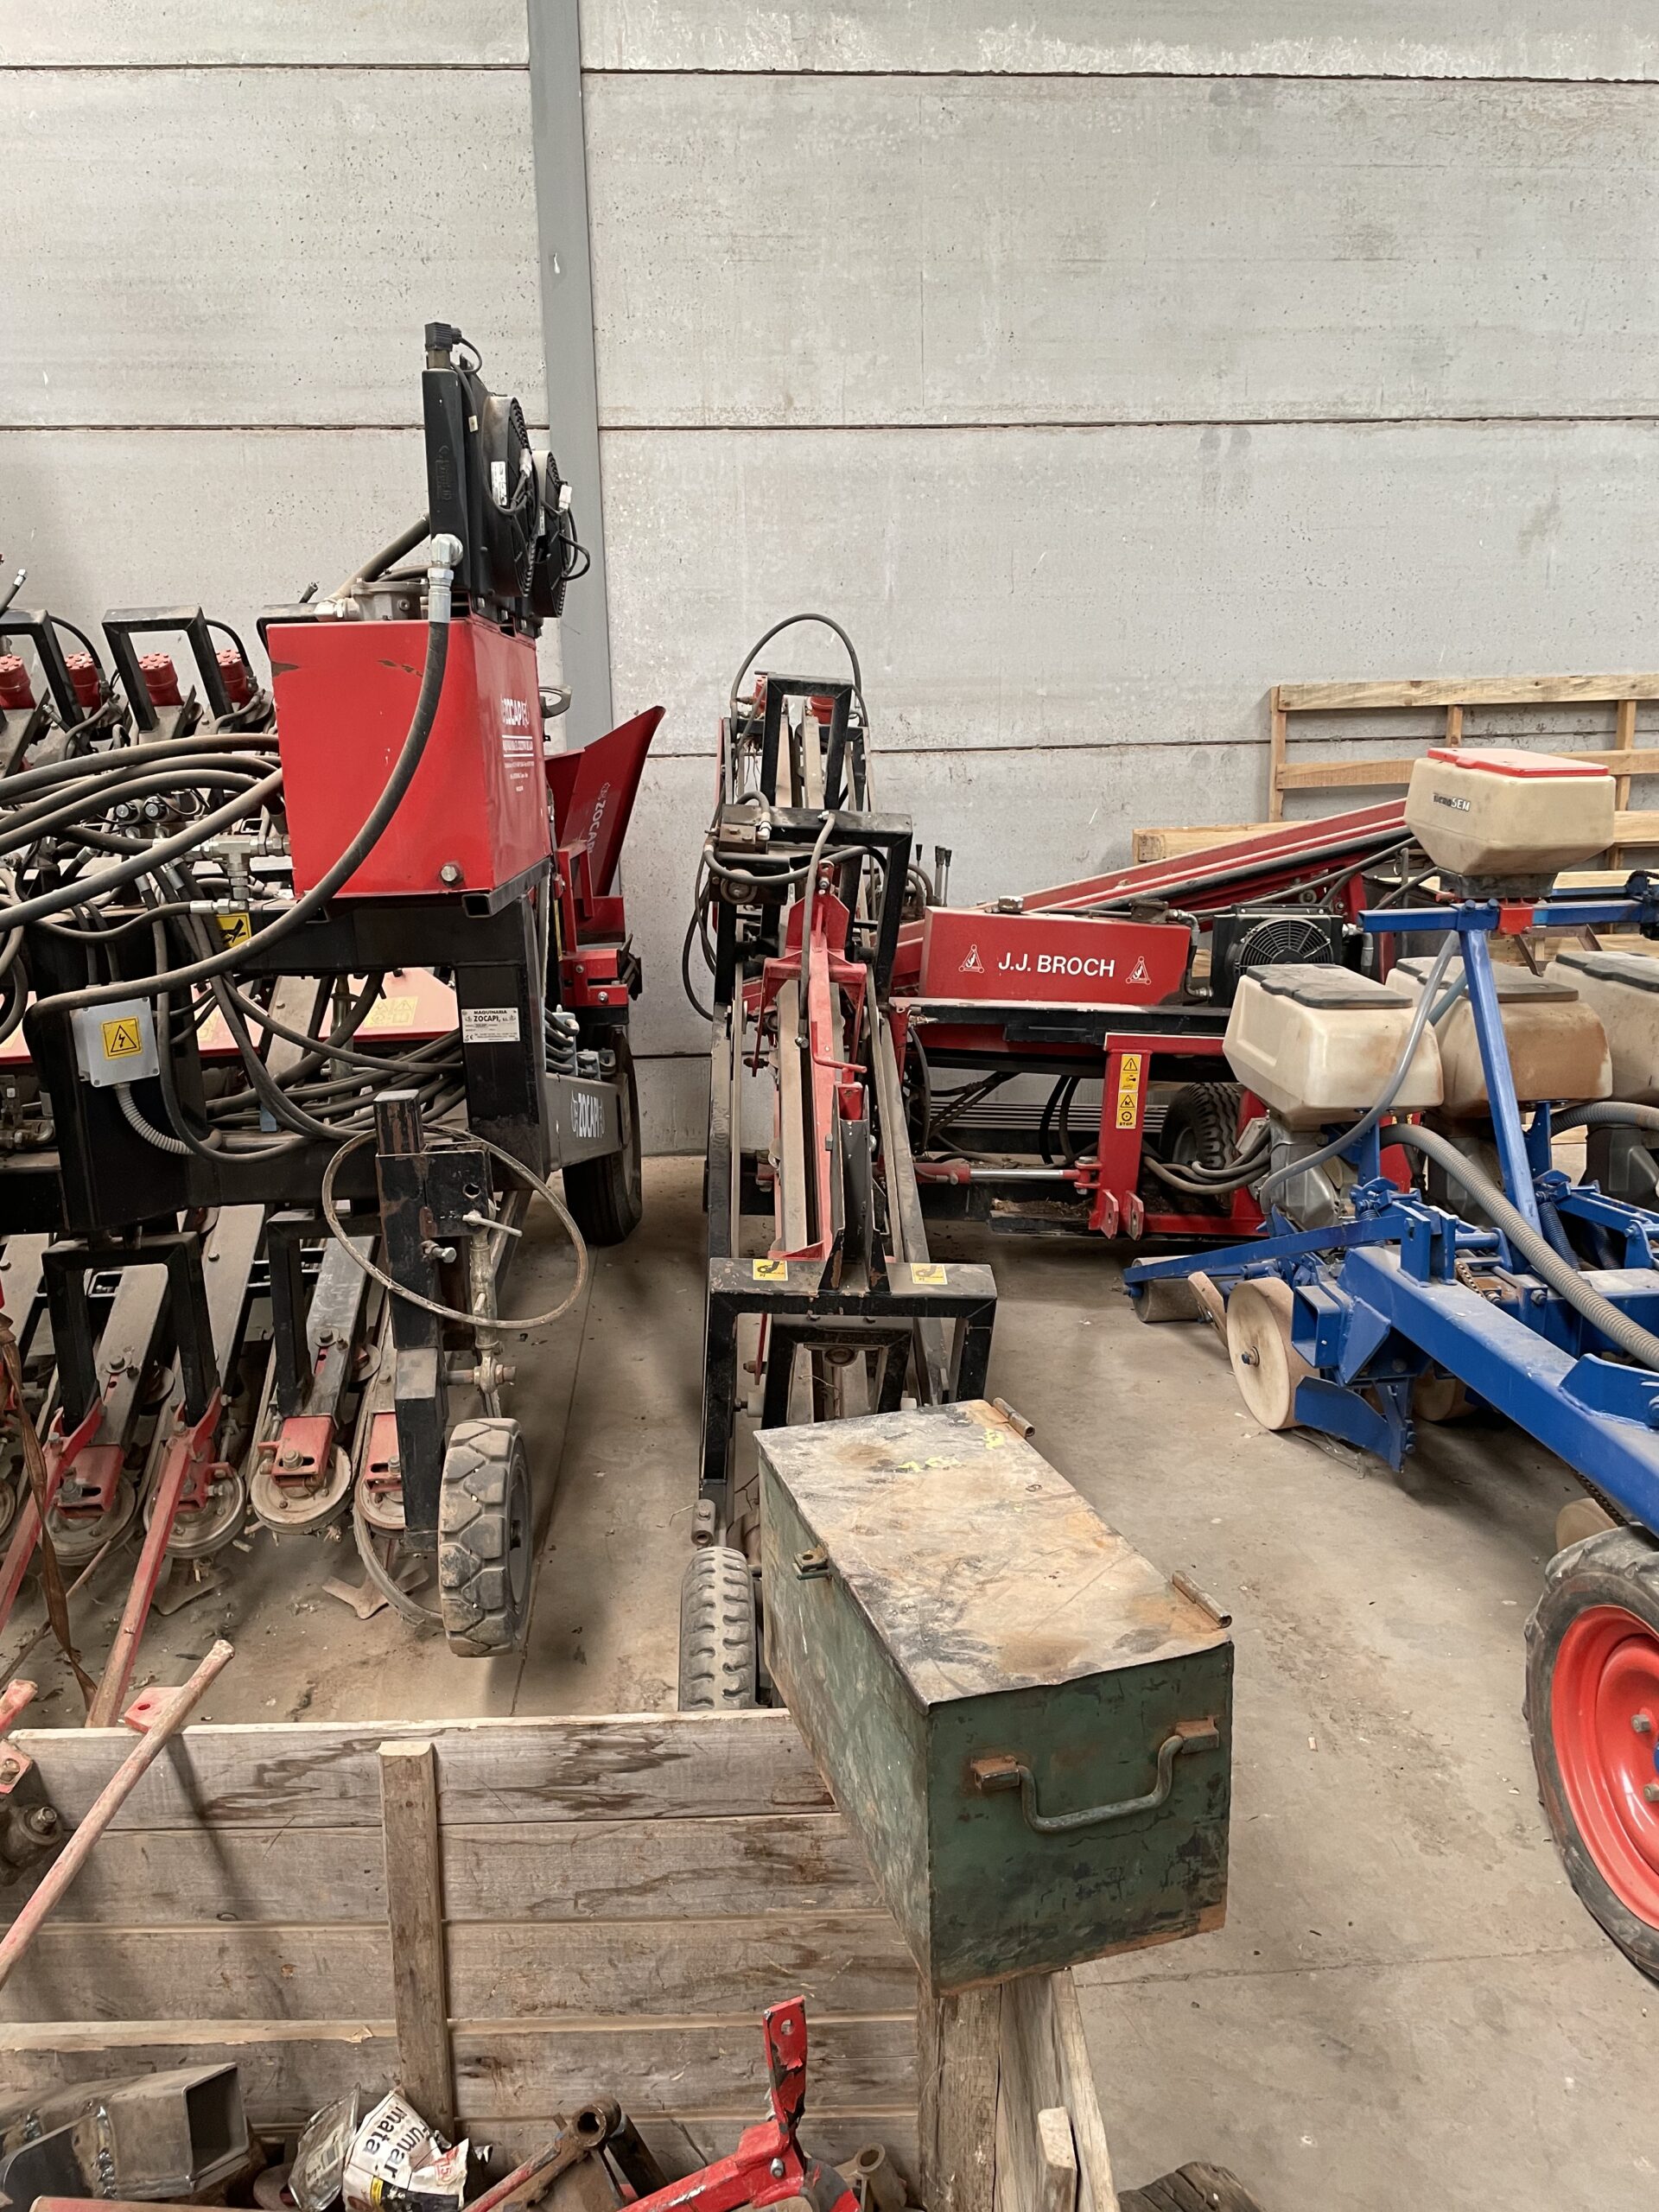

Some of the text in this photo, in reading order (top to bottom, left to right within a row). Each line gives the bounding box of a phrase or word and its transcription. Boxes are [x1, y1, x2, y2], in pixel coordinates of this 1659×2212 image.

[998, 952, 1116, 977] J.J. BROCH
[362, 2106, 408, 2156] mata
